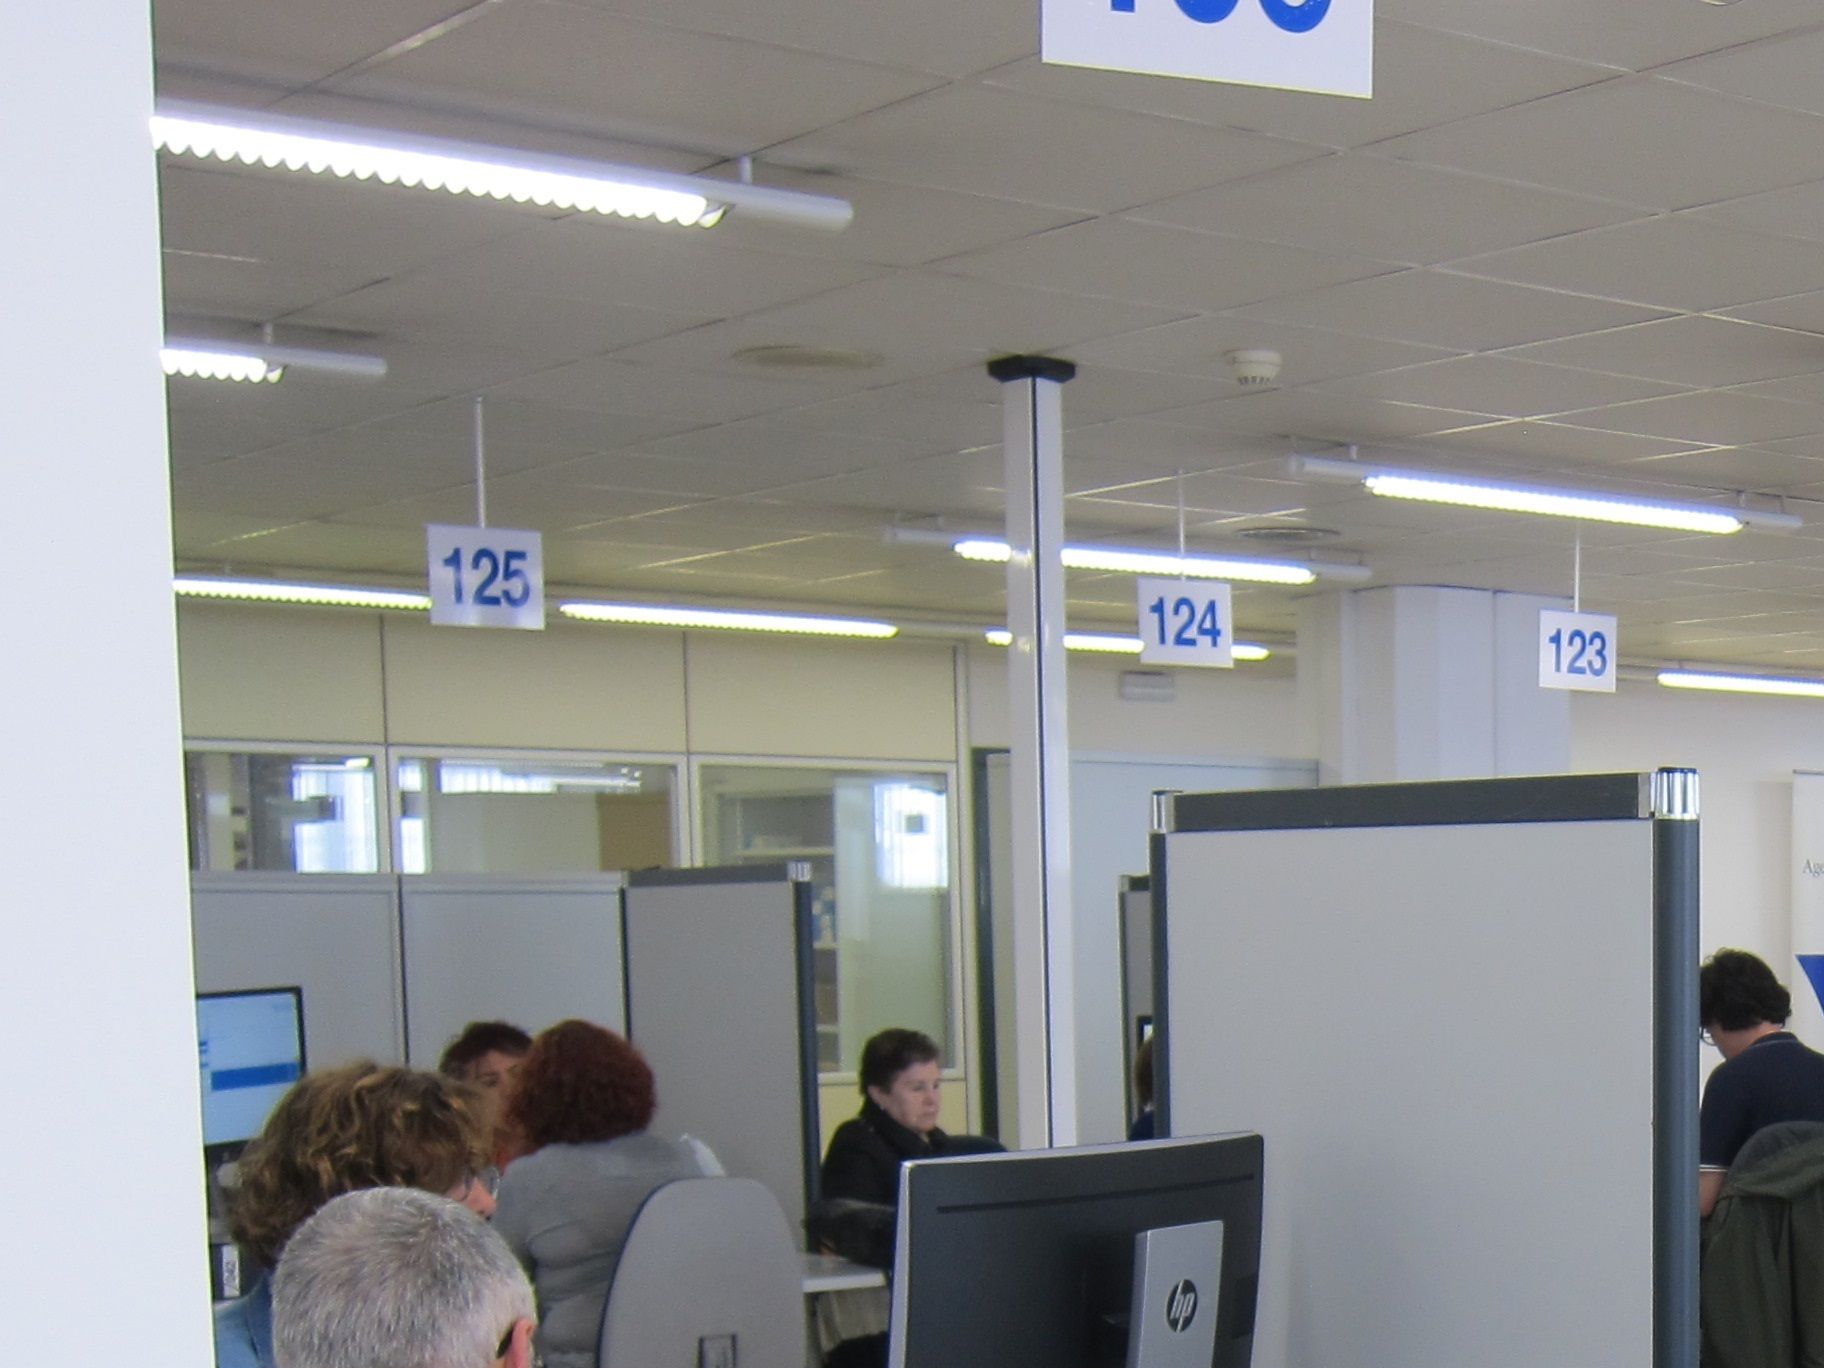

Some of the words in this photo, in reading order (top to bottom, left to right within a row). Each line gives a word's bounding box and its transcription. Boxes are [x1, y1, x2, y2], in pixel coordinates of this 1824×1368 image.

[443, 547, 530, 608] 125
[1149, 596, 1221, 648] 124
[1548, 628, 1607, 677] 123
